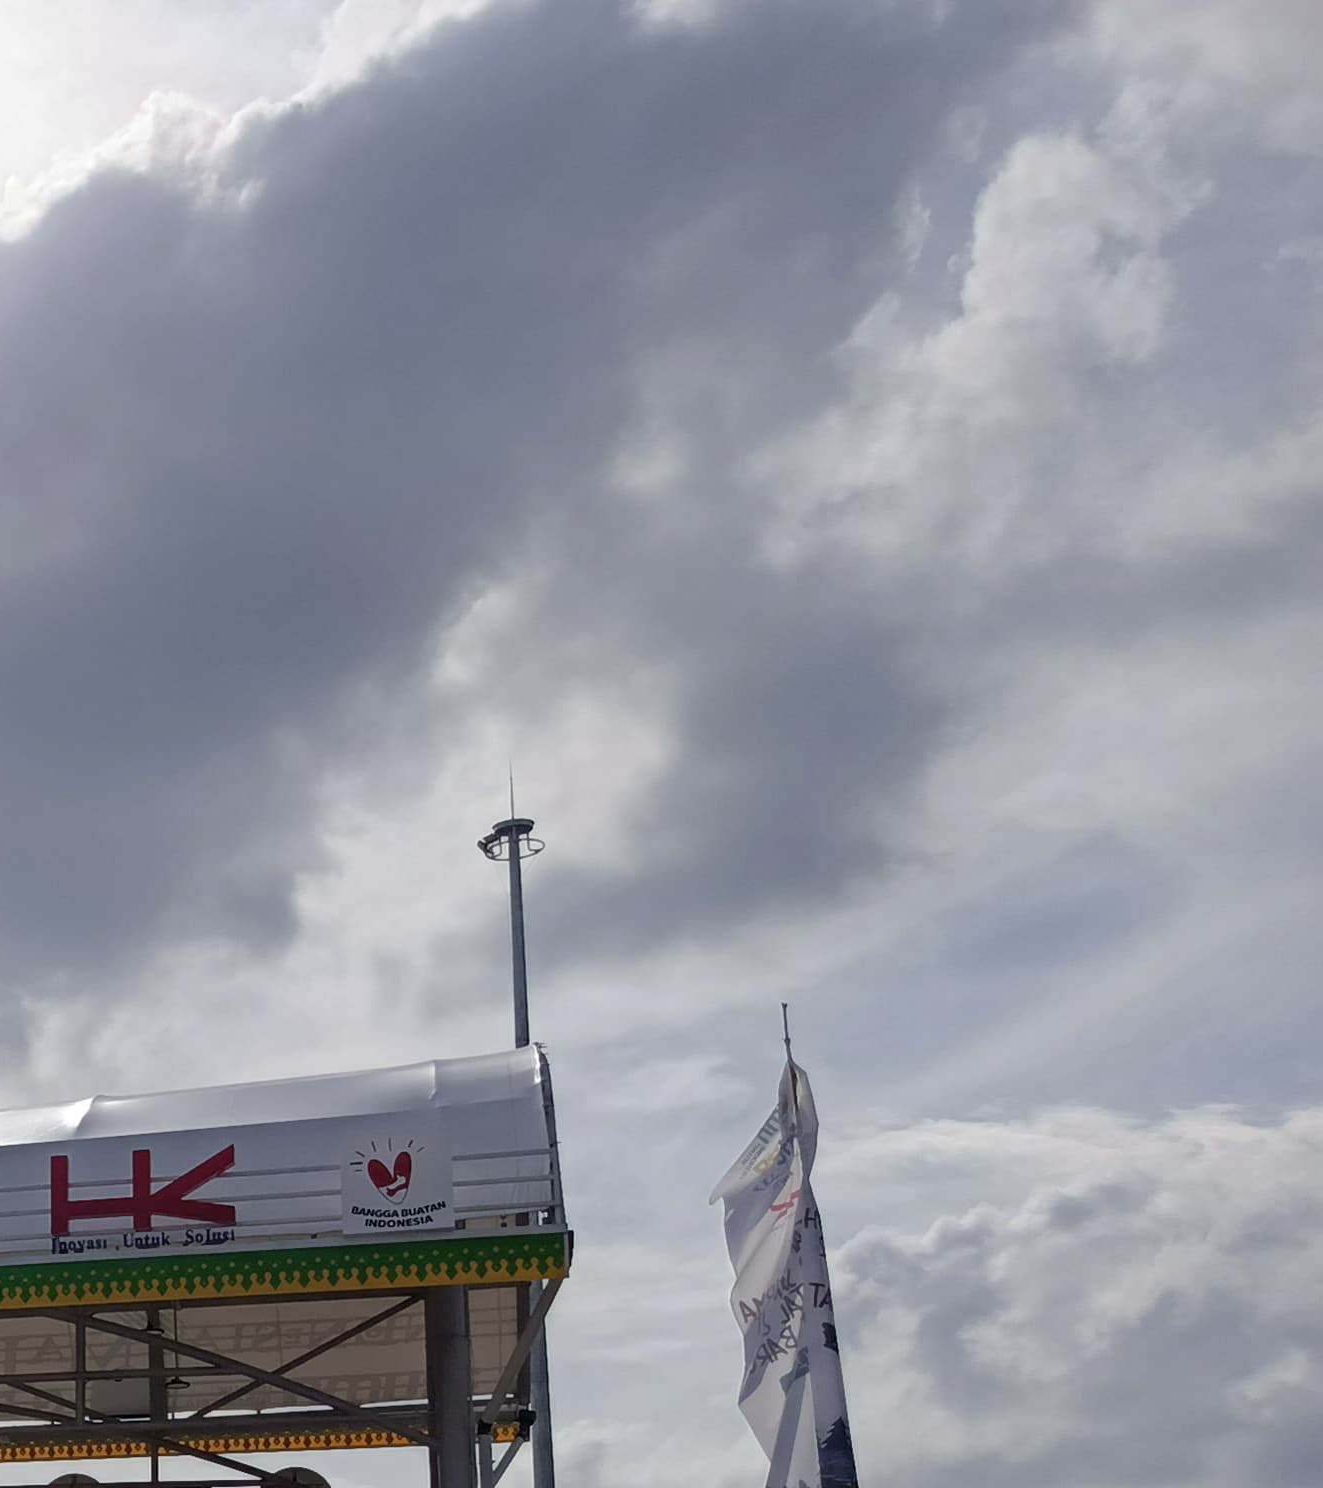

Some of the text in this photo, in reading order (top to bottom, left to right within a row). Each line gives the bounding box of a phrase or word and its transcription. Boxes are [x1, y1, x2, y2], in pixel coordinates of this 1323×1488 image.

[50, 1143, 236, 1237] HK
[350, 1200, 447, 1218] BANGGA BUATAN
[364, 1215, 434, 1228] INDONESIA
